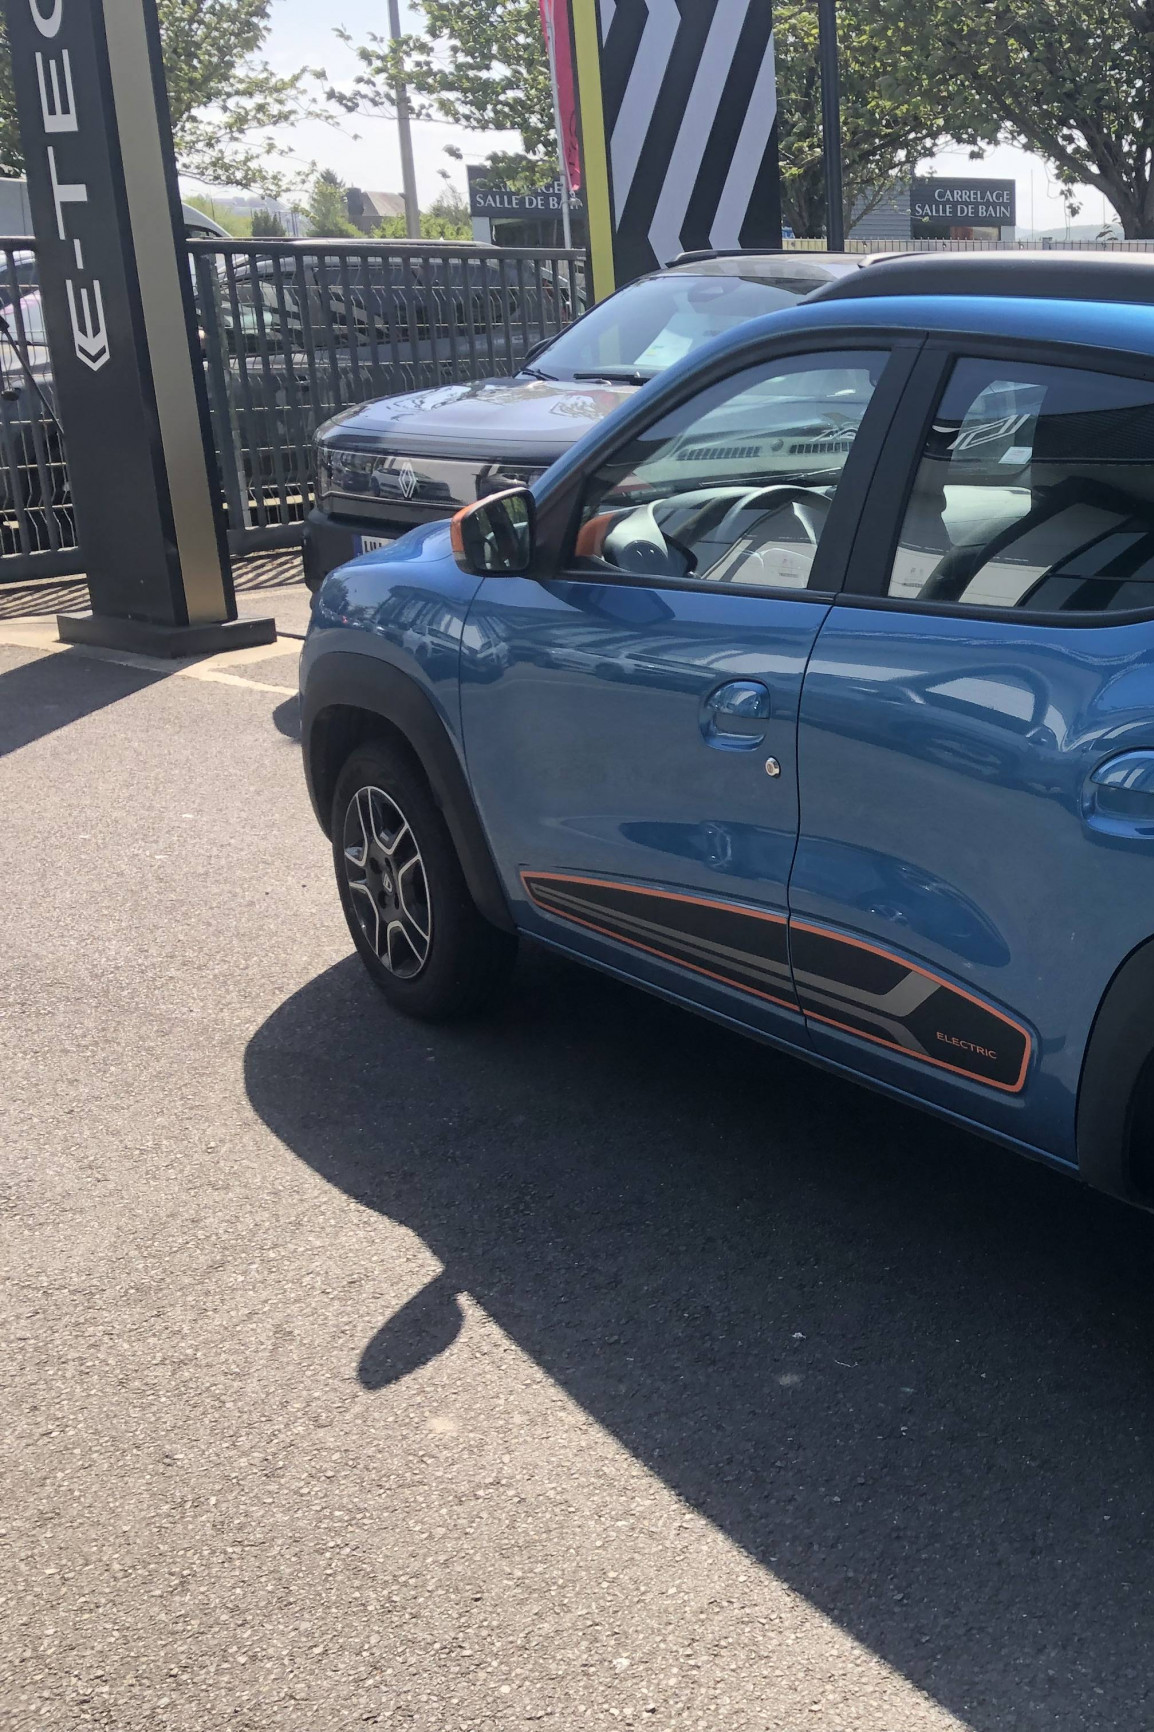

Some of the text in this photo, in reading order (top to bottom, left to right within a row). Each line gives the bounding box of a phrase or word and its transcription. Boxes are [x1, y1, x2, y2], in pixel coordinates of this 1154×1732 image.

[476, 194, 519, 208] SALLE
[525, 196, 545, 209] DE
[935, 189, 1010, 203] CARRELAGE
[915, 204, 1011, 218] SALLE DE BAIN
[936, 1031, 998, 1059] ELECTRIC
